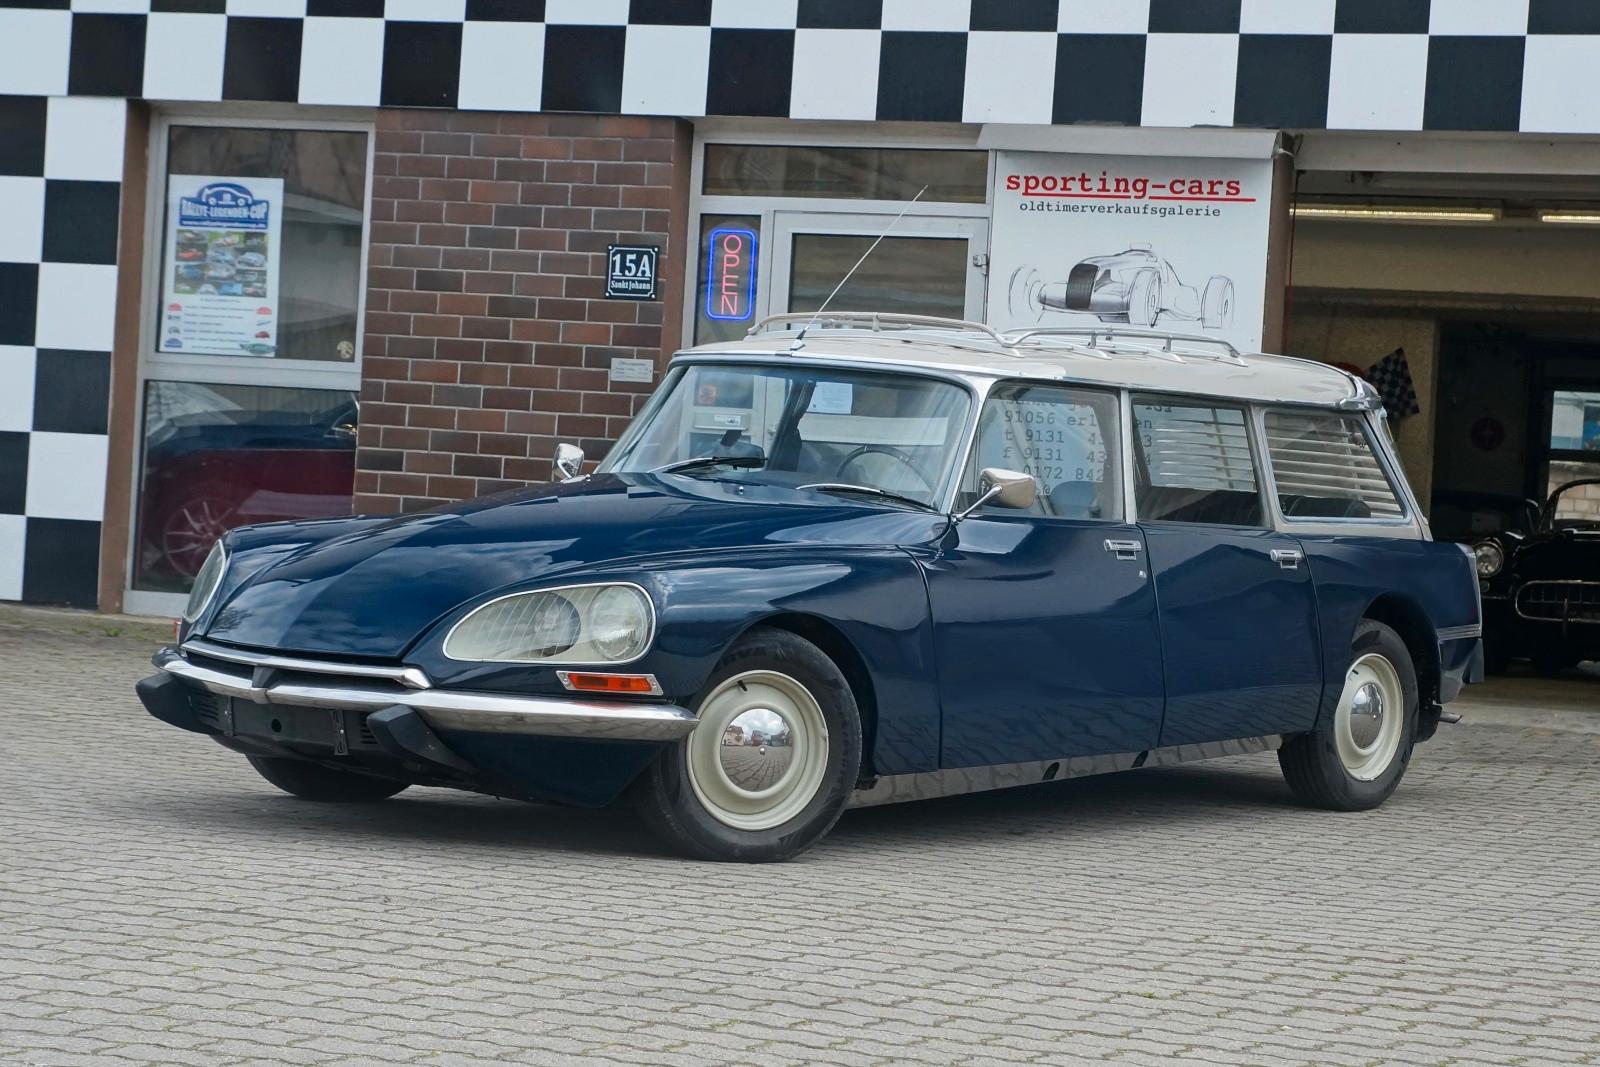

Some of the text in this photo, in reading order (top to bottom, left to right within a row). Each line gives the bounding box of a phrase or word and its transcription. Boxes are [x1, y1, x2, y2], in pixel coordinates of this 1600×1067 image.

[1006, 171, 1241, 199] sporting-cars
[1019, 201, 1221, 217] oldtimerverkaufsgalerie
[612, 253, 651, 277] 15A
[721, 234, 742, 316] OPEN
[610, 280, 628, 289] Sankt
[1004, 410, 1056, 425] 91056
[1025, 431, 1065, 443] 9131
[1023, 448, 1064, 461] 9131
